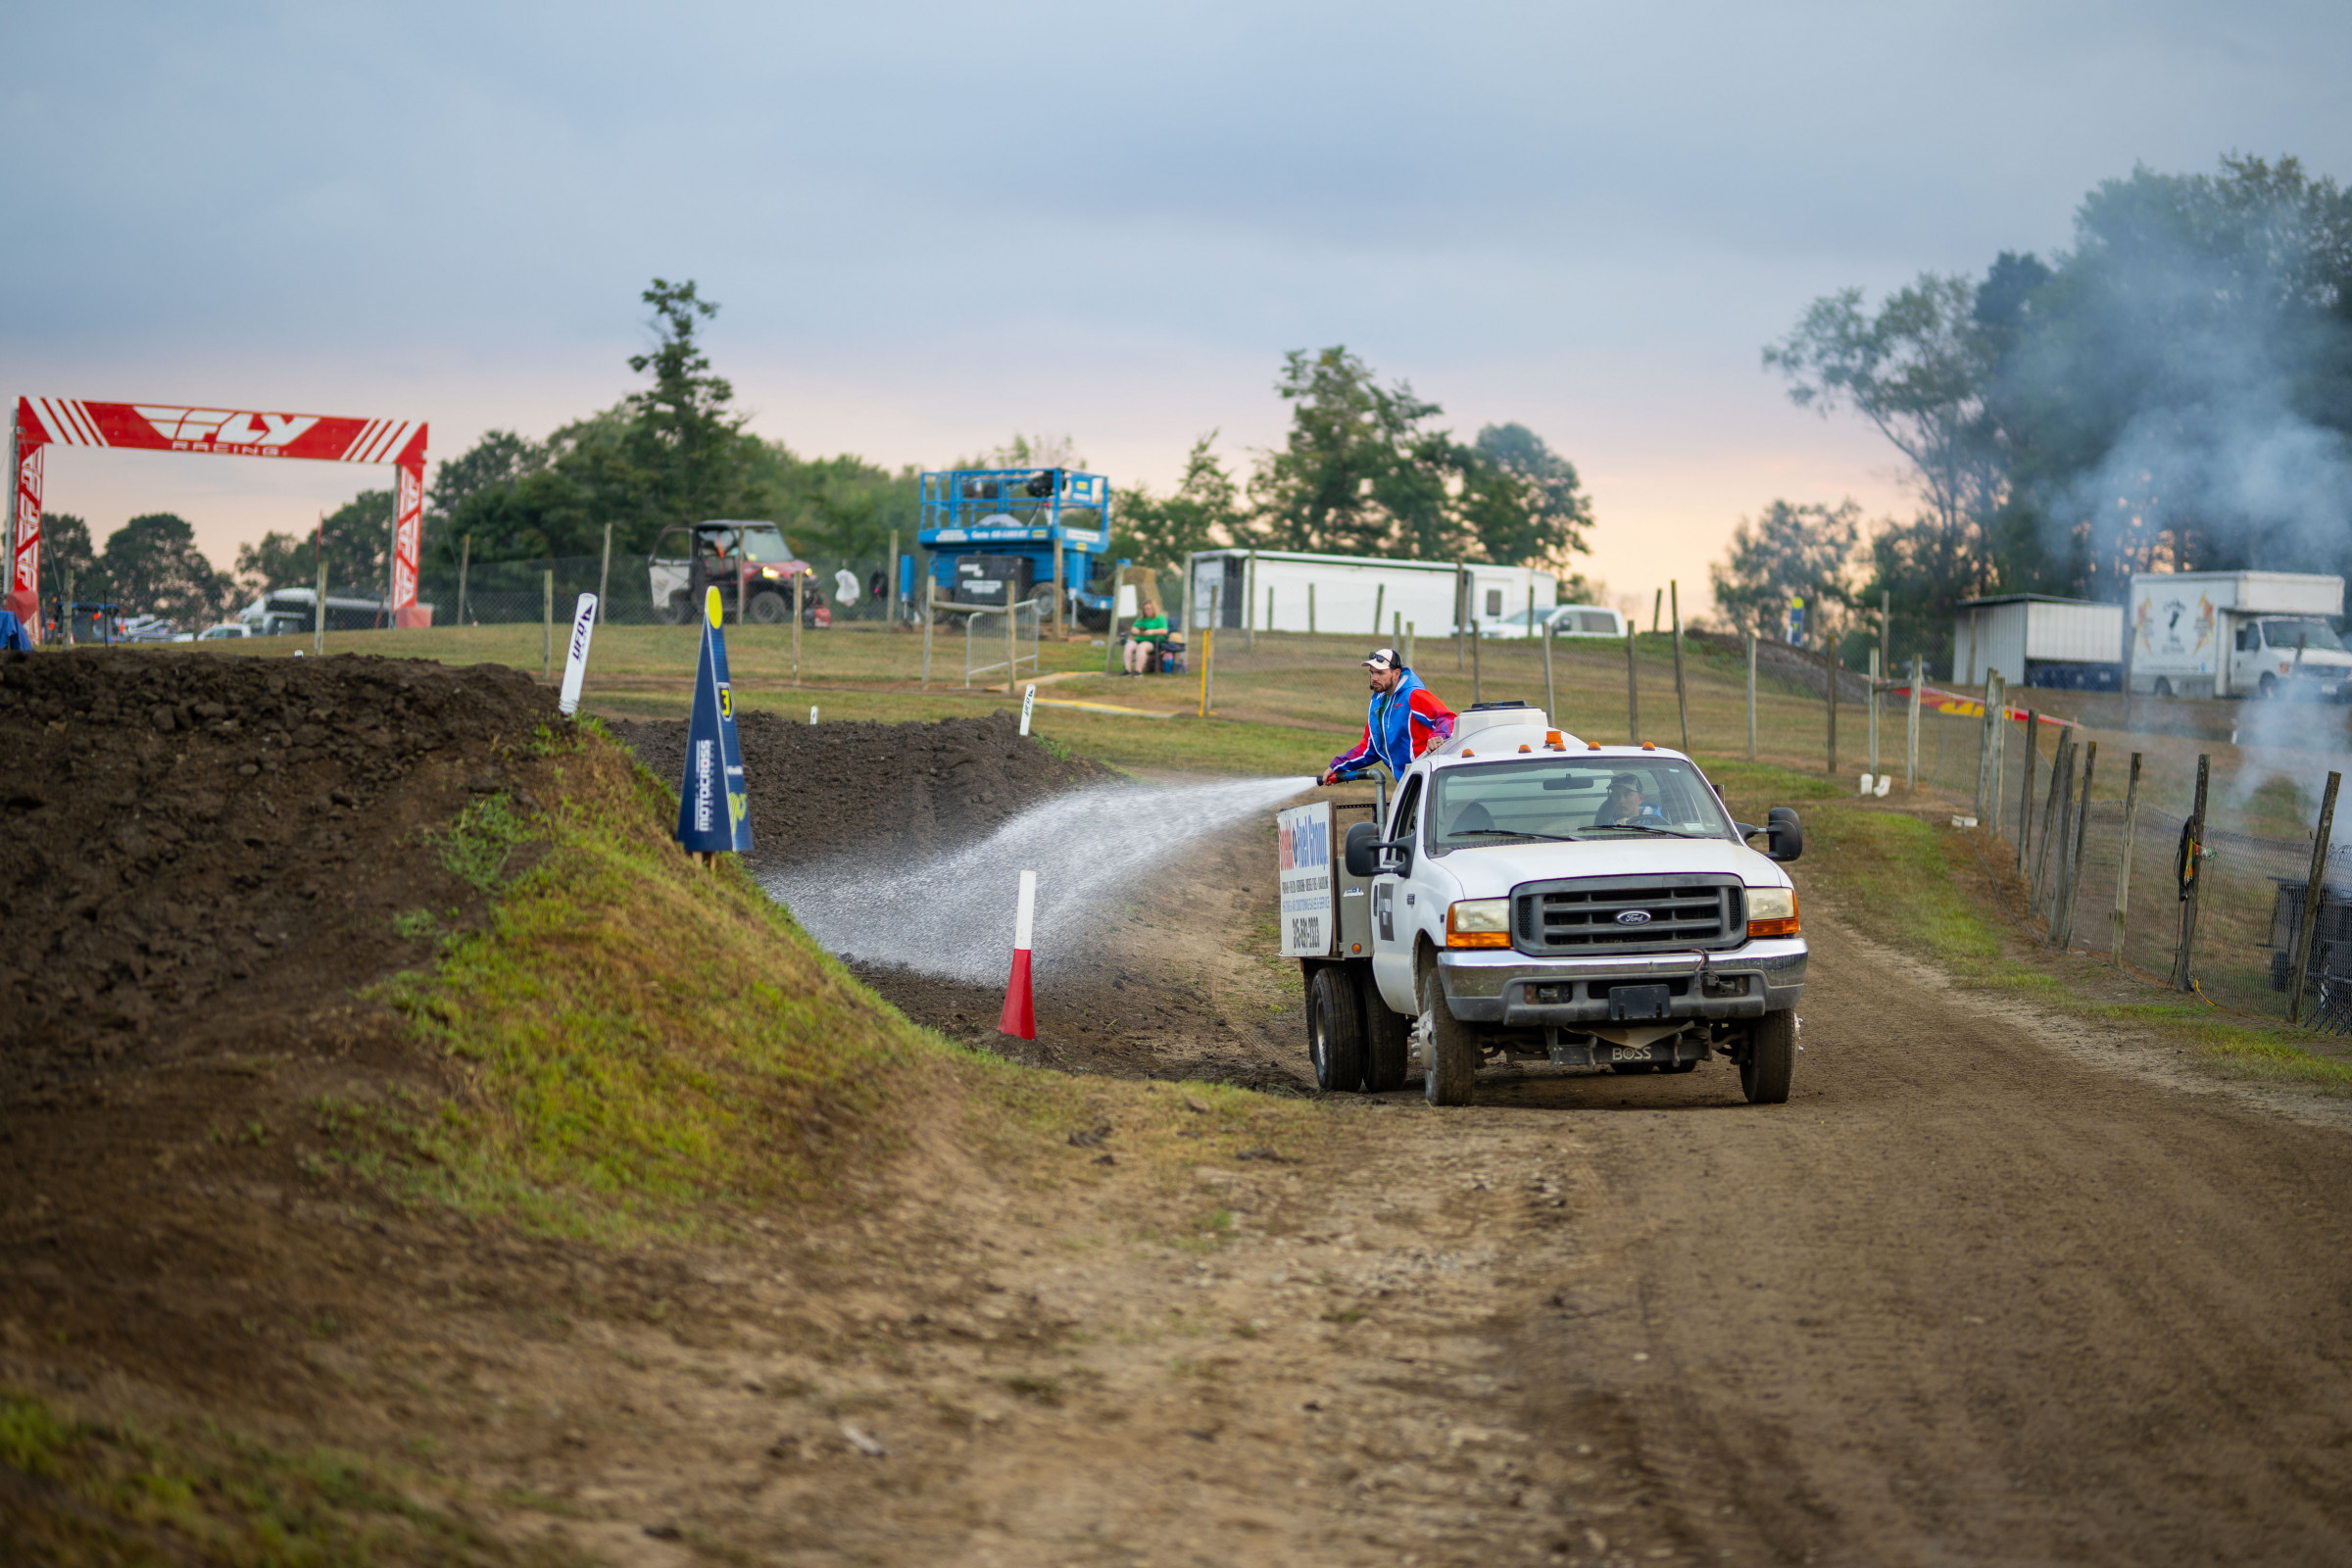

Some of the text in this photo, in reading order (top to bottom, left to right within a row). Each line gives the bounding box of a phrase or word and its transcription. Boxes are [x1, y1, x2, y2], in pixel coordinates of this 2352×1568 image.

[132, 405, 320, 447] FLY
[172, 440, 279, 457] RACING
[572, 620, 585, 661] UFO
[699, 739, 710, 832] MOTOCROSS
[1626, 913, 1643, 922] Ford
[1612, 1046, 1652, 1060] BOSS
